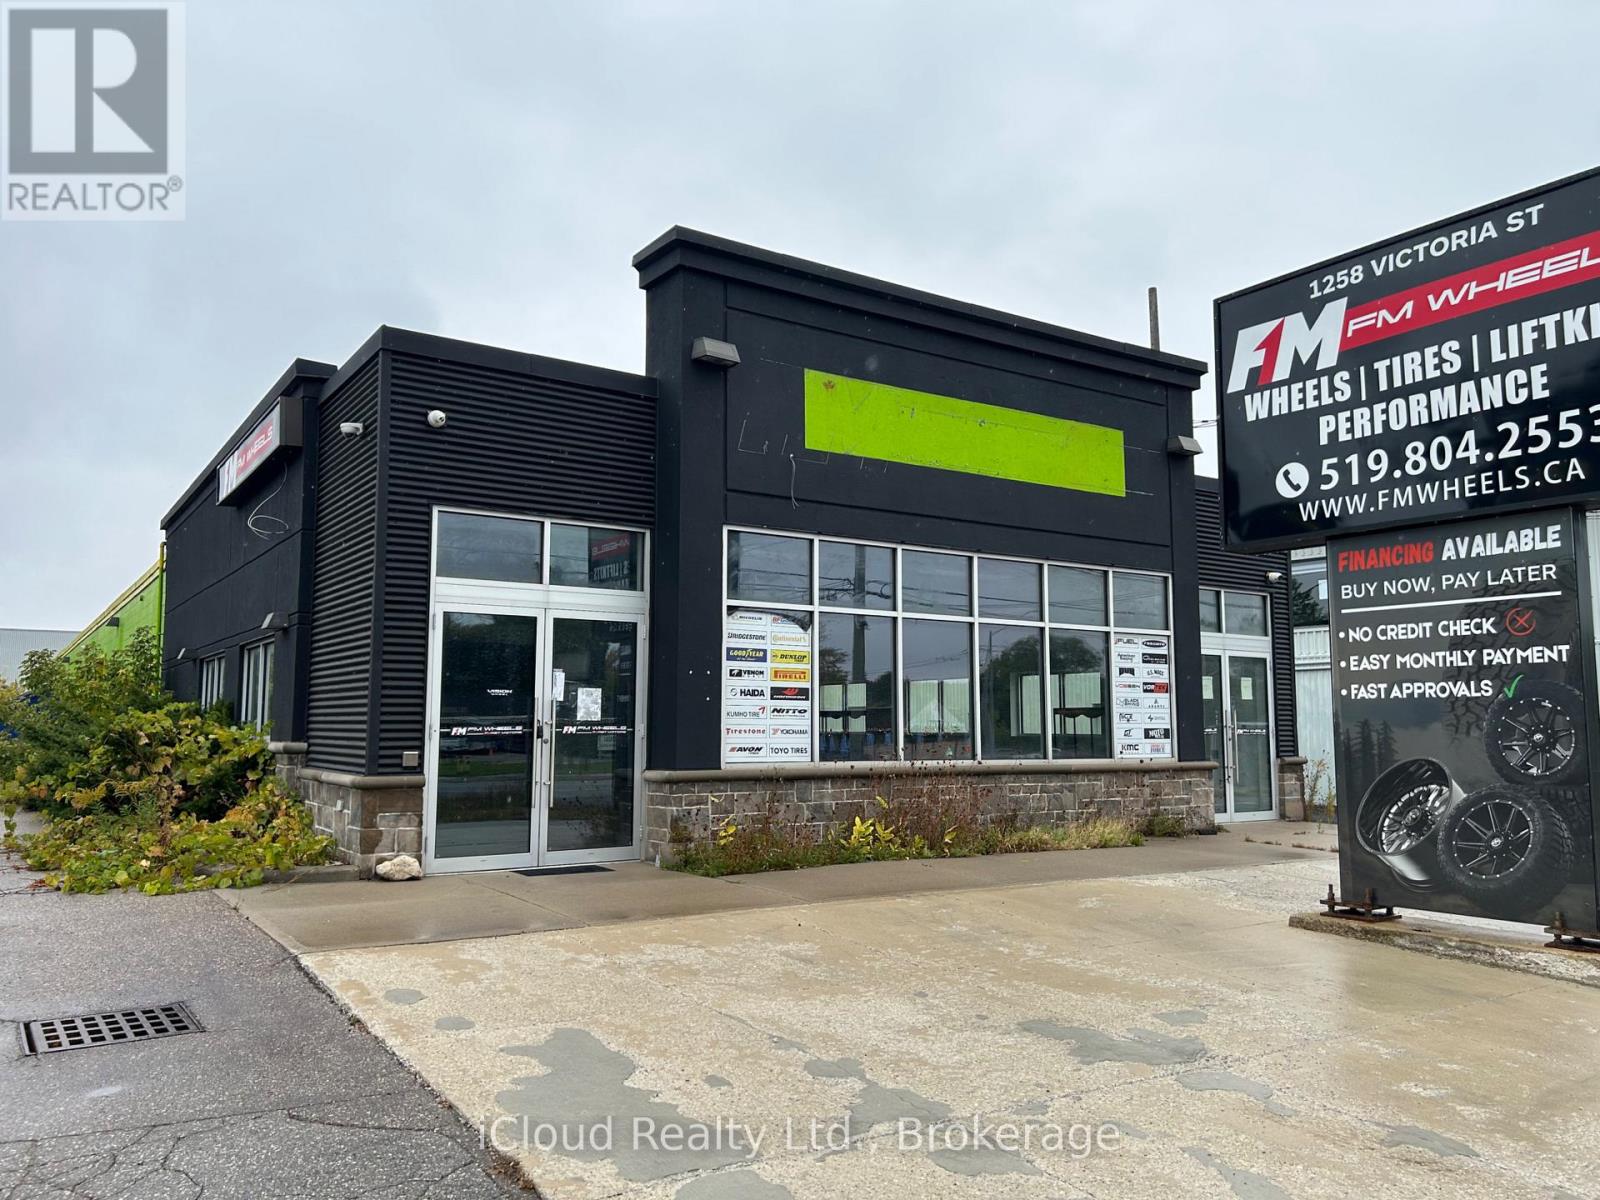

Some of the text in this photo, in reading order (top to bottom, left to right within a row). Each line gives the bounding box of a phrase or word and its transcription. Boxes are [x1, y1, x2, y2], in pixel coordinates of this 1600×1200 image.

[1308, 203, 1544, 299] 1258 VICTORIA ST
[1347, 300, 1414, 338] FM
[1244, 370, 1351, 422] WHEELS
[1374, 341, 1461, 392] TIRES
[1319, 363, 1550, 446] PERFORMANCE
[1299, 458, 1585, 522] WWW.FMWHEELS.CA
[1338, 525, 1561, 572] FINANCING AVAILABLE
[1341, 564, 1557, 599] BUY NOW, PAY LATER
[1349, 617, 1497, 642] NO CREDIT CHECK
[1350, 645, 1569, 671] EASY MONTHLY PAYMENT
[740, 688, 765, 697] HAIDA
[1351, 680, 1493, 699] FAST APPROVALS
